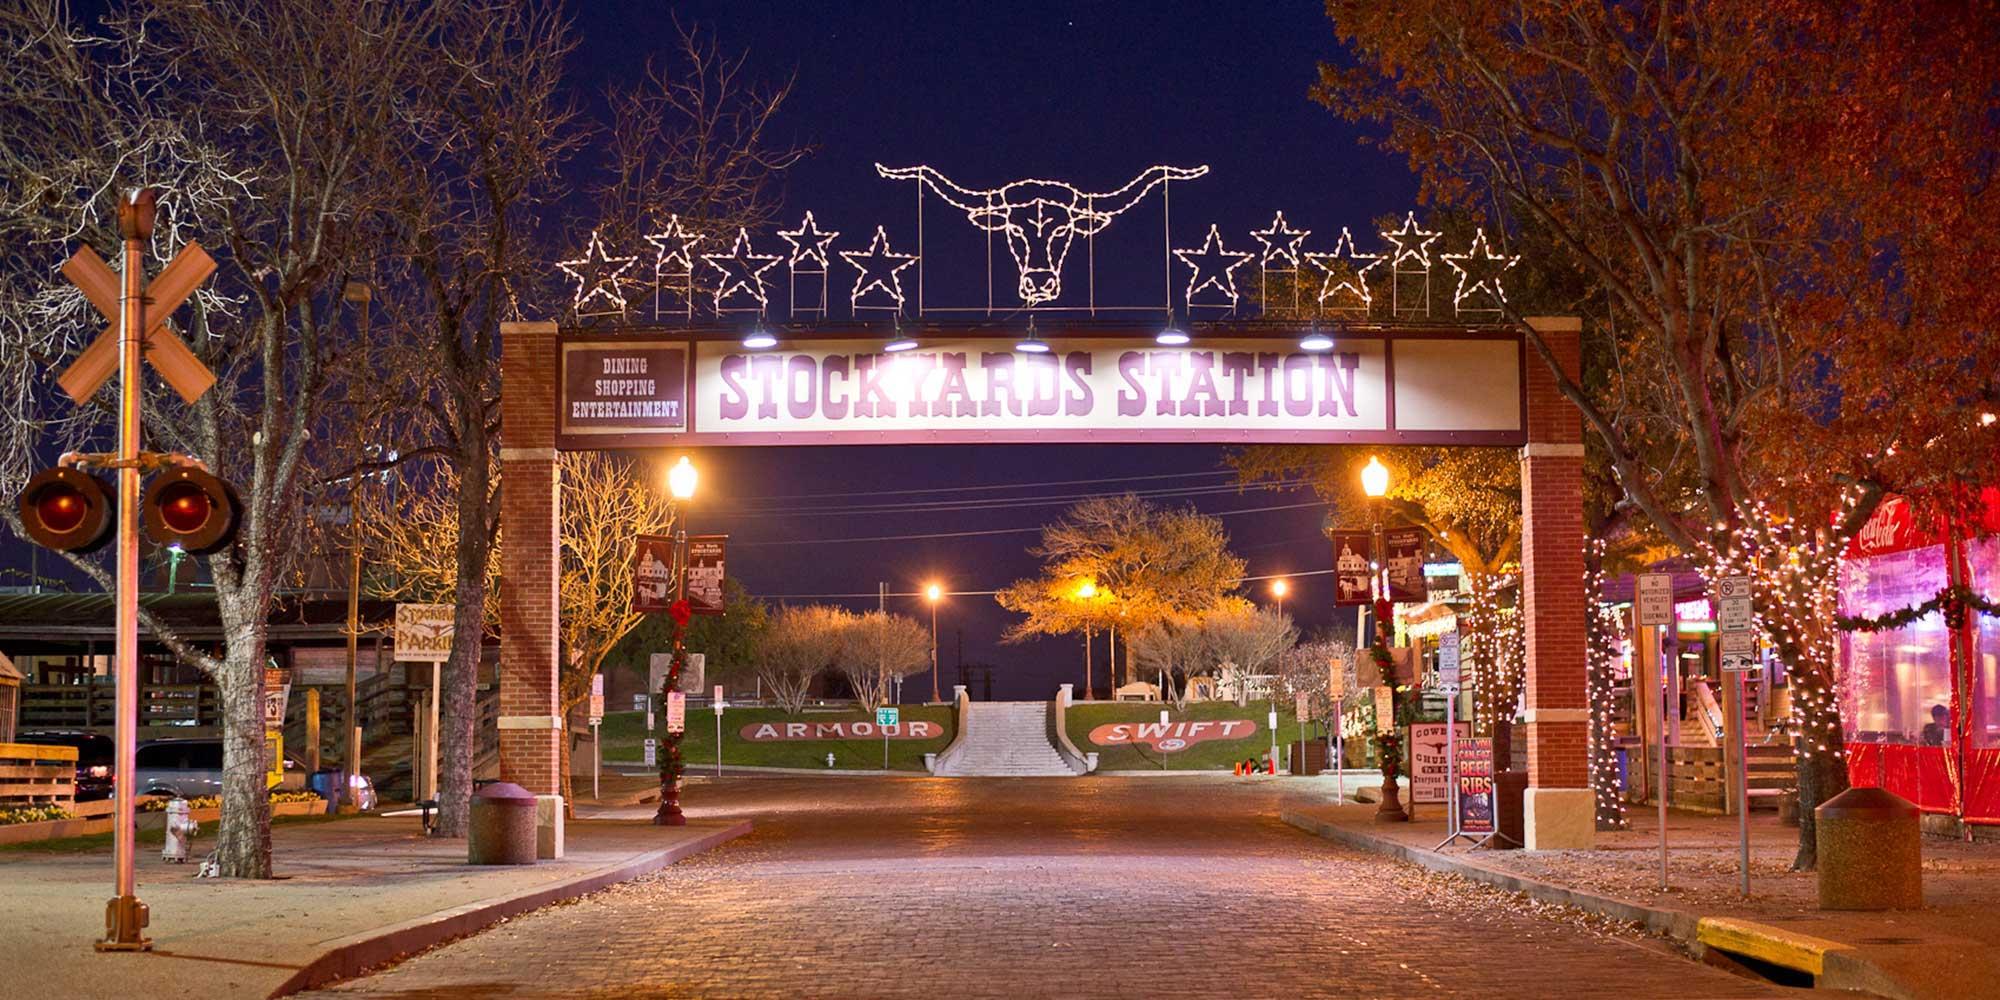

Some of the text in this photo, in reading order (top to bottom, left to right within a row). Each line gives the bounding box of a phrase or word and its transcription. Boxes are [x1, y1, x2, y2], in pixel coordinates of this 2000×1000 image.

[603, 358, 648, 374] DINING
[595, 380, 656, 396] SHOPPING
[720, 351, 1360, 420] STOCKYARDS STATION
[572, 401, 679, 418] ENTERTAINMENT
[754, 722, 930, 739] ARMOUR
[1106, 721, 1242, 741] SWIFT
[1416, 728, 1462, 738] COWBY
[1460, 761, 1491, 776] BEEF
[1461, 777, 1492, 796] RIBS
